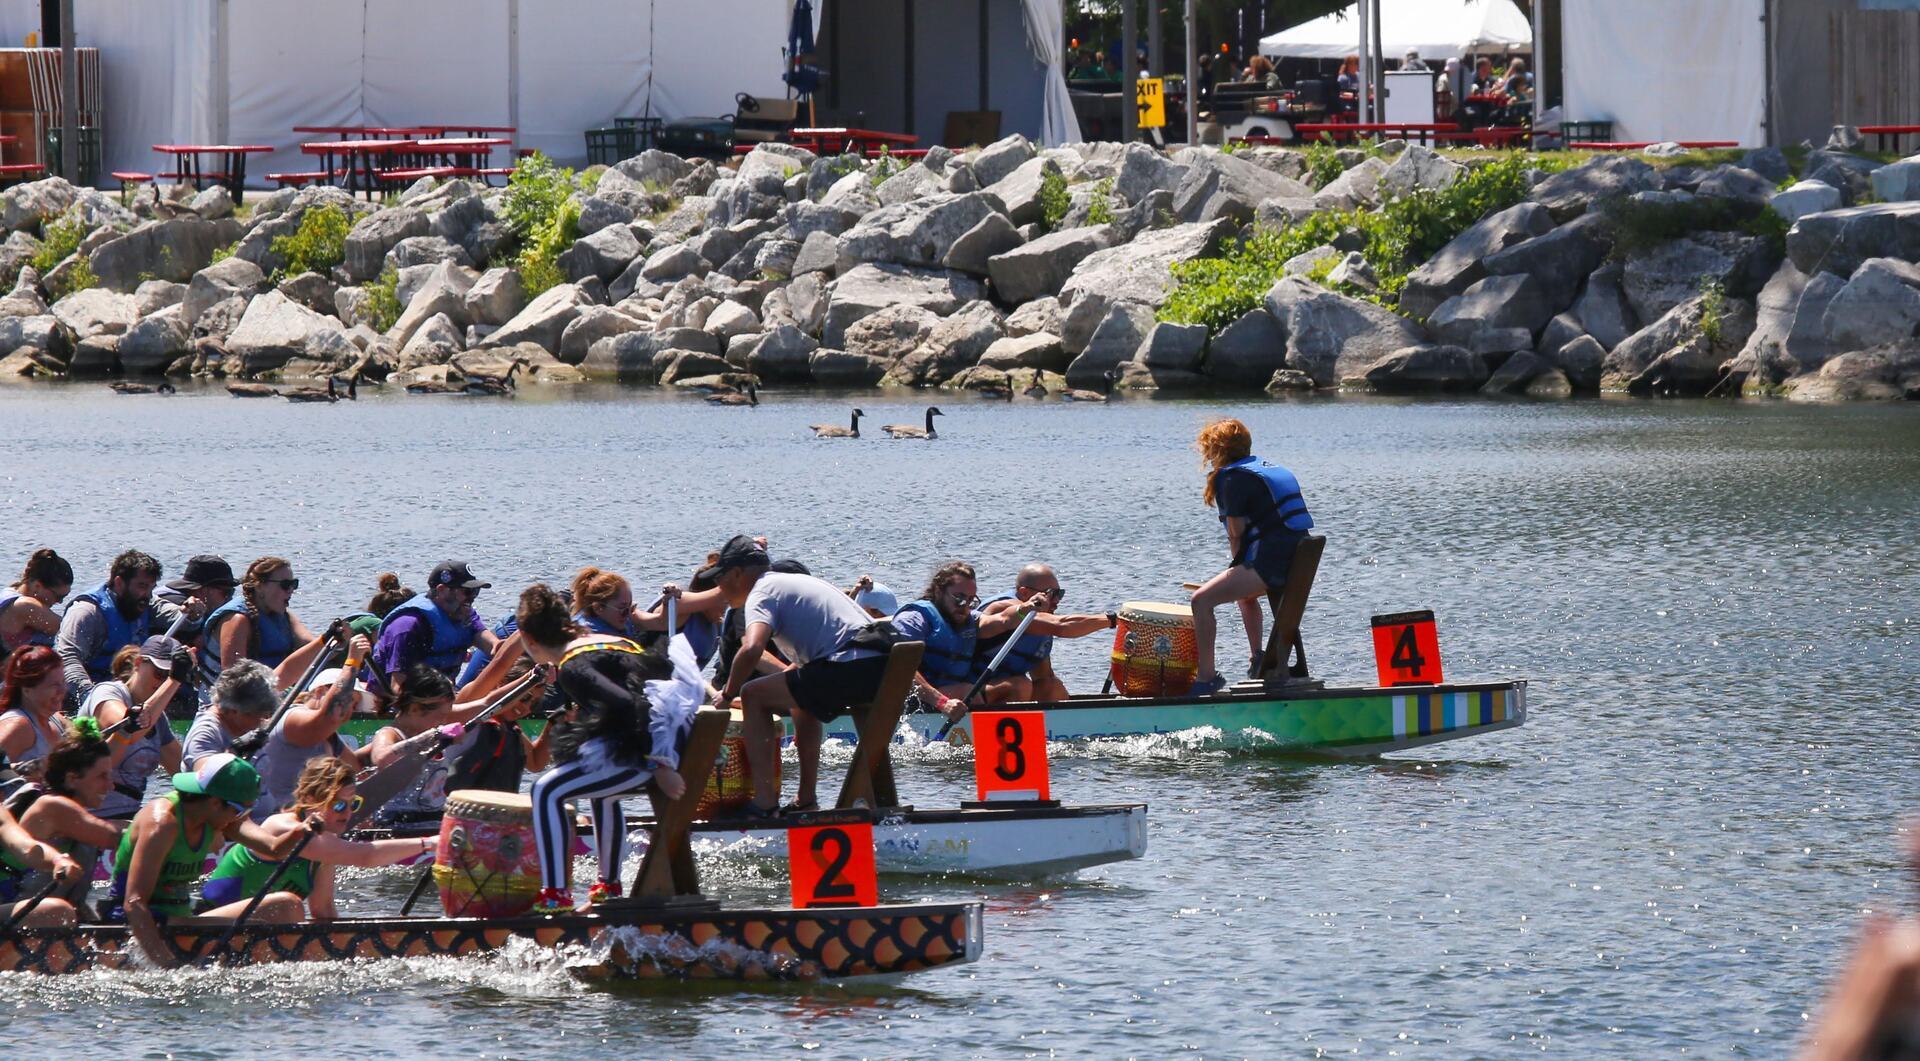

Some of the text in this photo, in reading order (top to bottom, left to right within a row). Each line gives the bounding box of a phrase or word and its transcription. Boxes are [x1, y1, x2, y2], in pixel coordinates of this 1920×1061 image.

[1136, 82, 1158, 96] XIT
[1390, 625, 1426, 677] 4
[995, 717, 1026, 782] 3
[810, 828, 855, 898] 2
